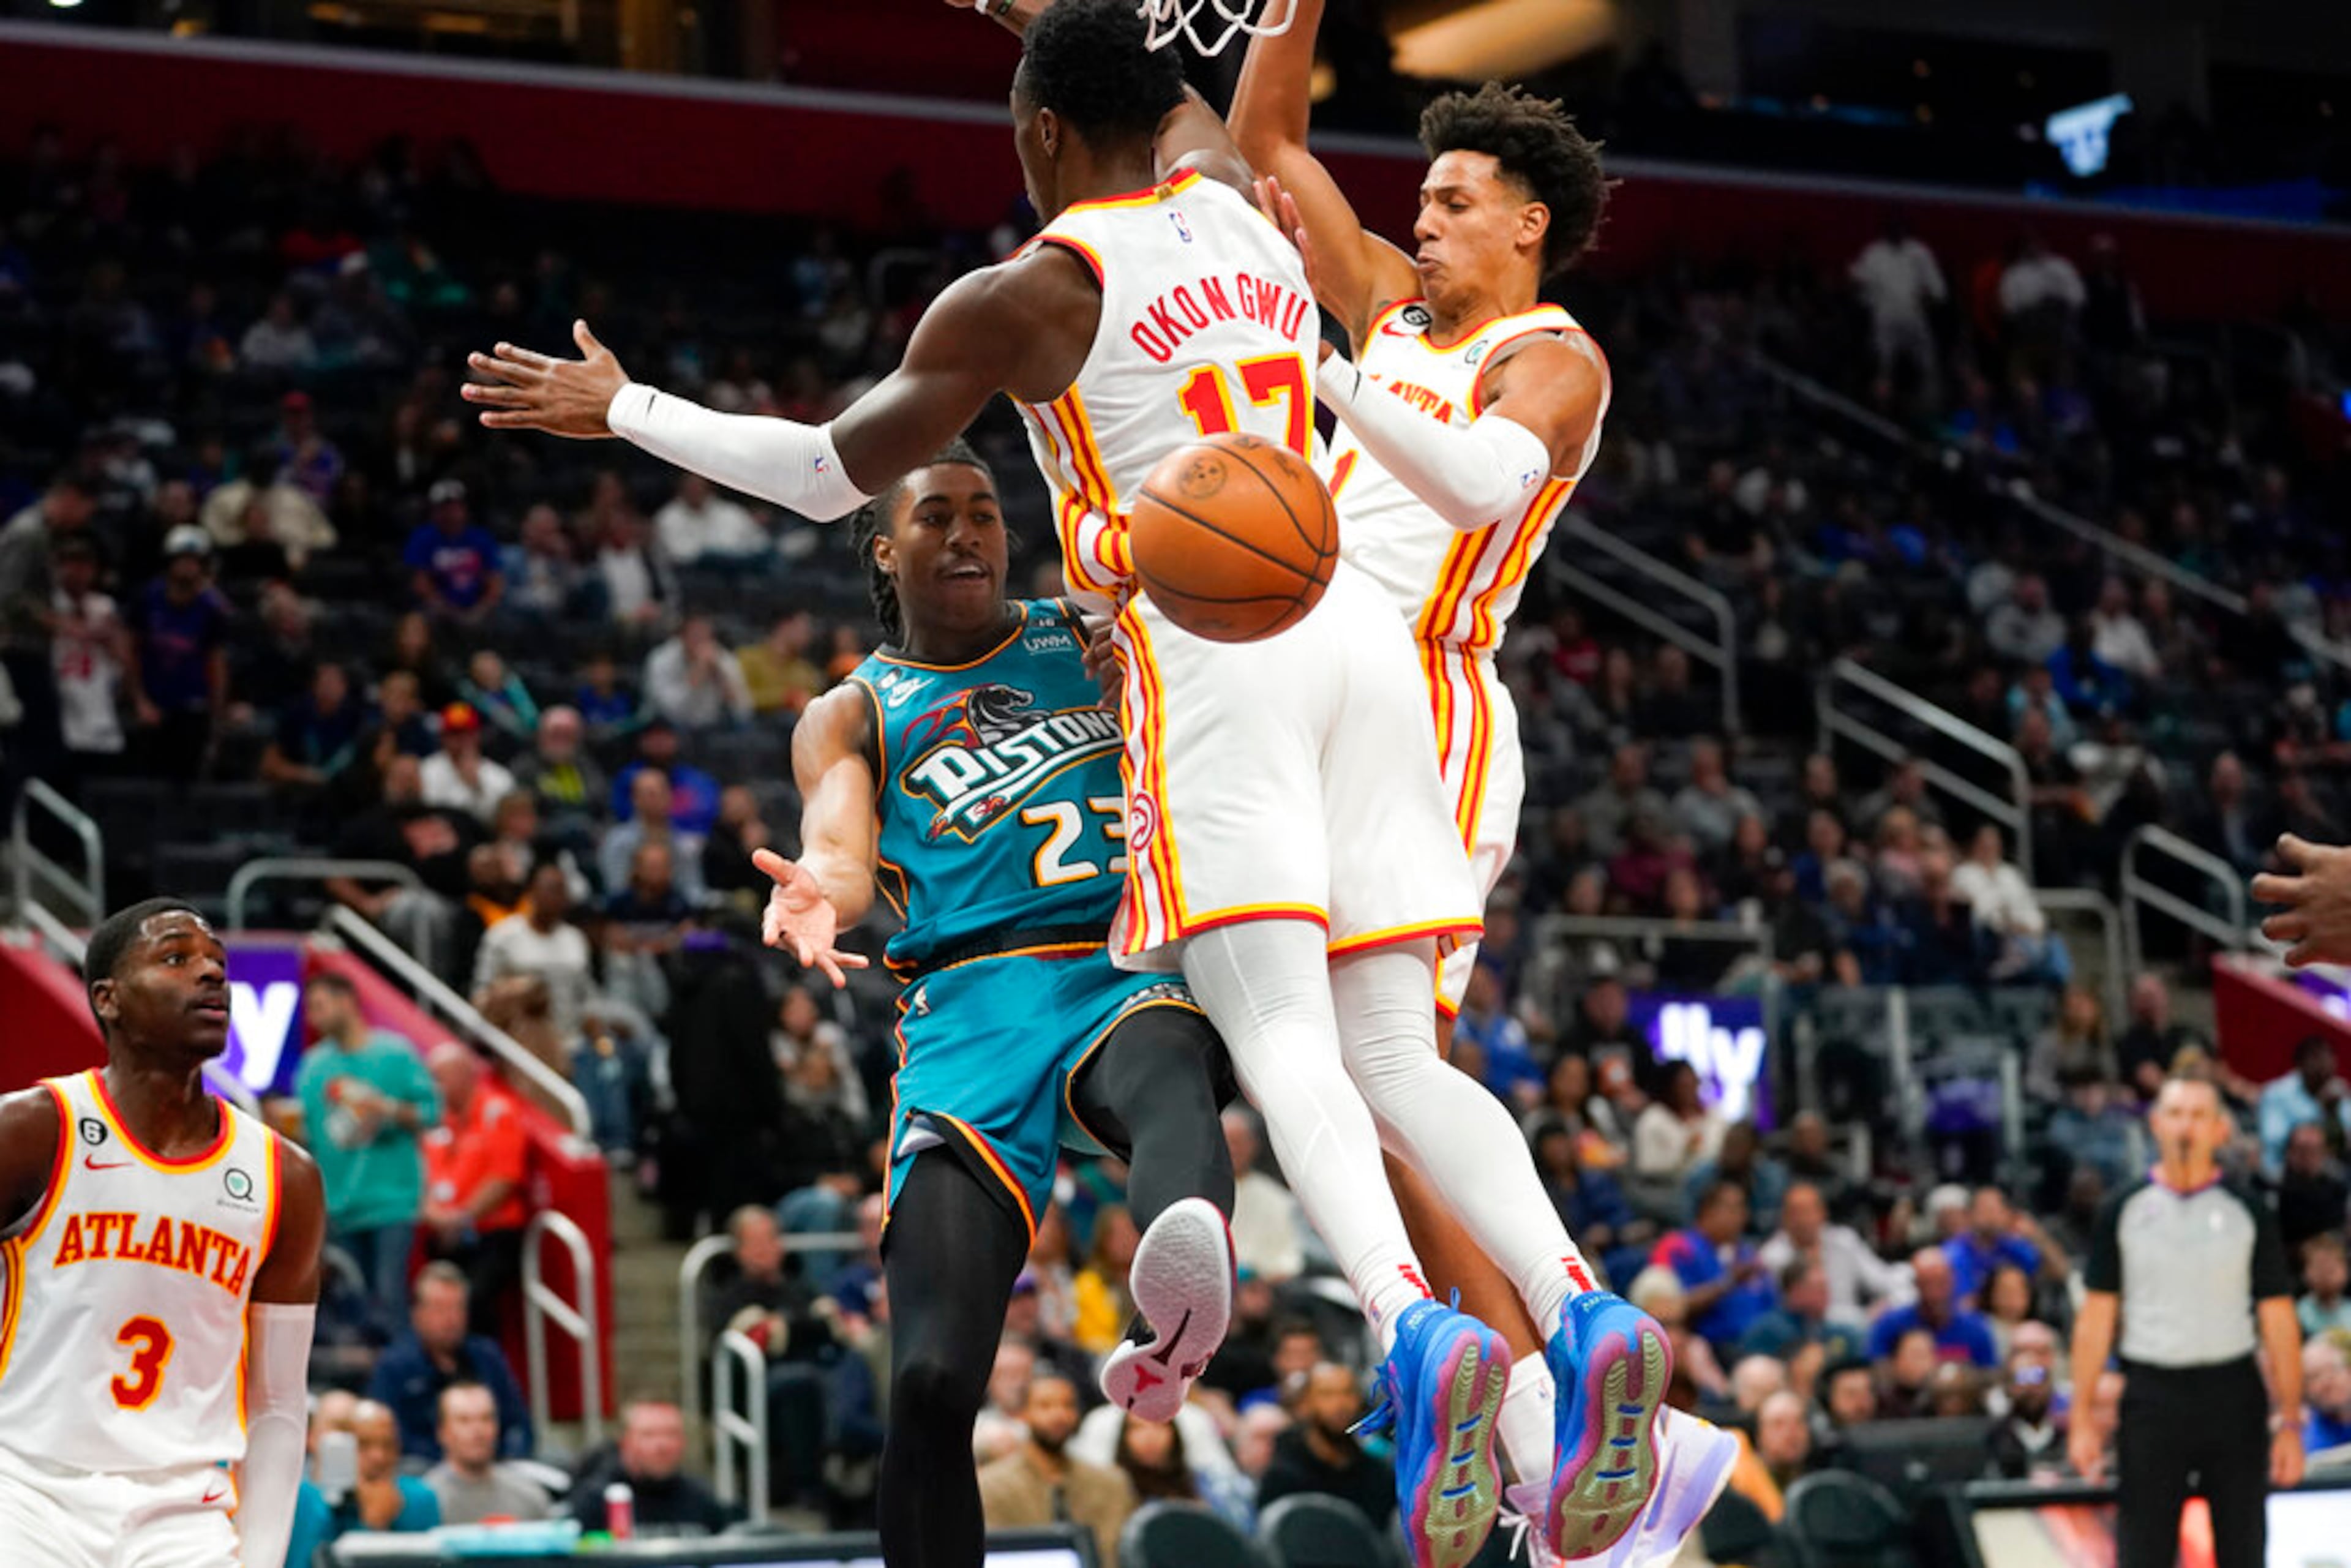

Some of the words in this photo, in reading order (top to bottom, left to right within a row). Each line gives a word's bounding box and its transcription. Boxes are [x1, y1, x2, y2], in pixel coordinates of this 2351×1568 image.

[1130, 273, 1308, 363] OKONGWU
[1177, 351, 1313, 463] 17
[909, 708, 1127, 825] PISTONS
[53, 1212, 252, 1298] ATLANTA
[110, 1314, 176, 1412] 3
